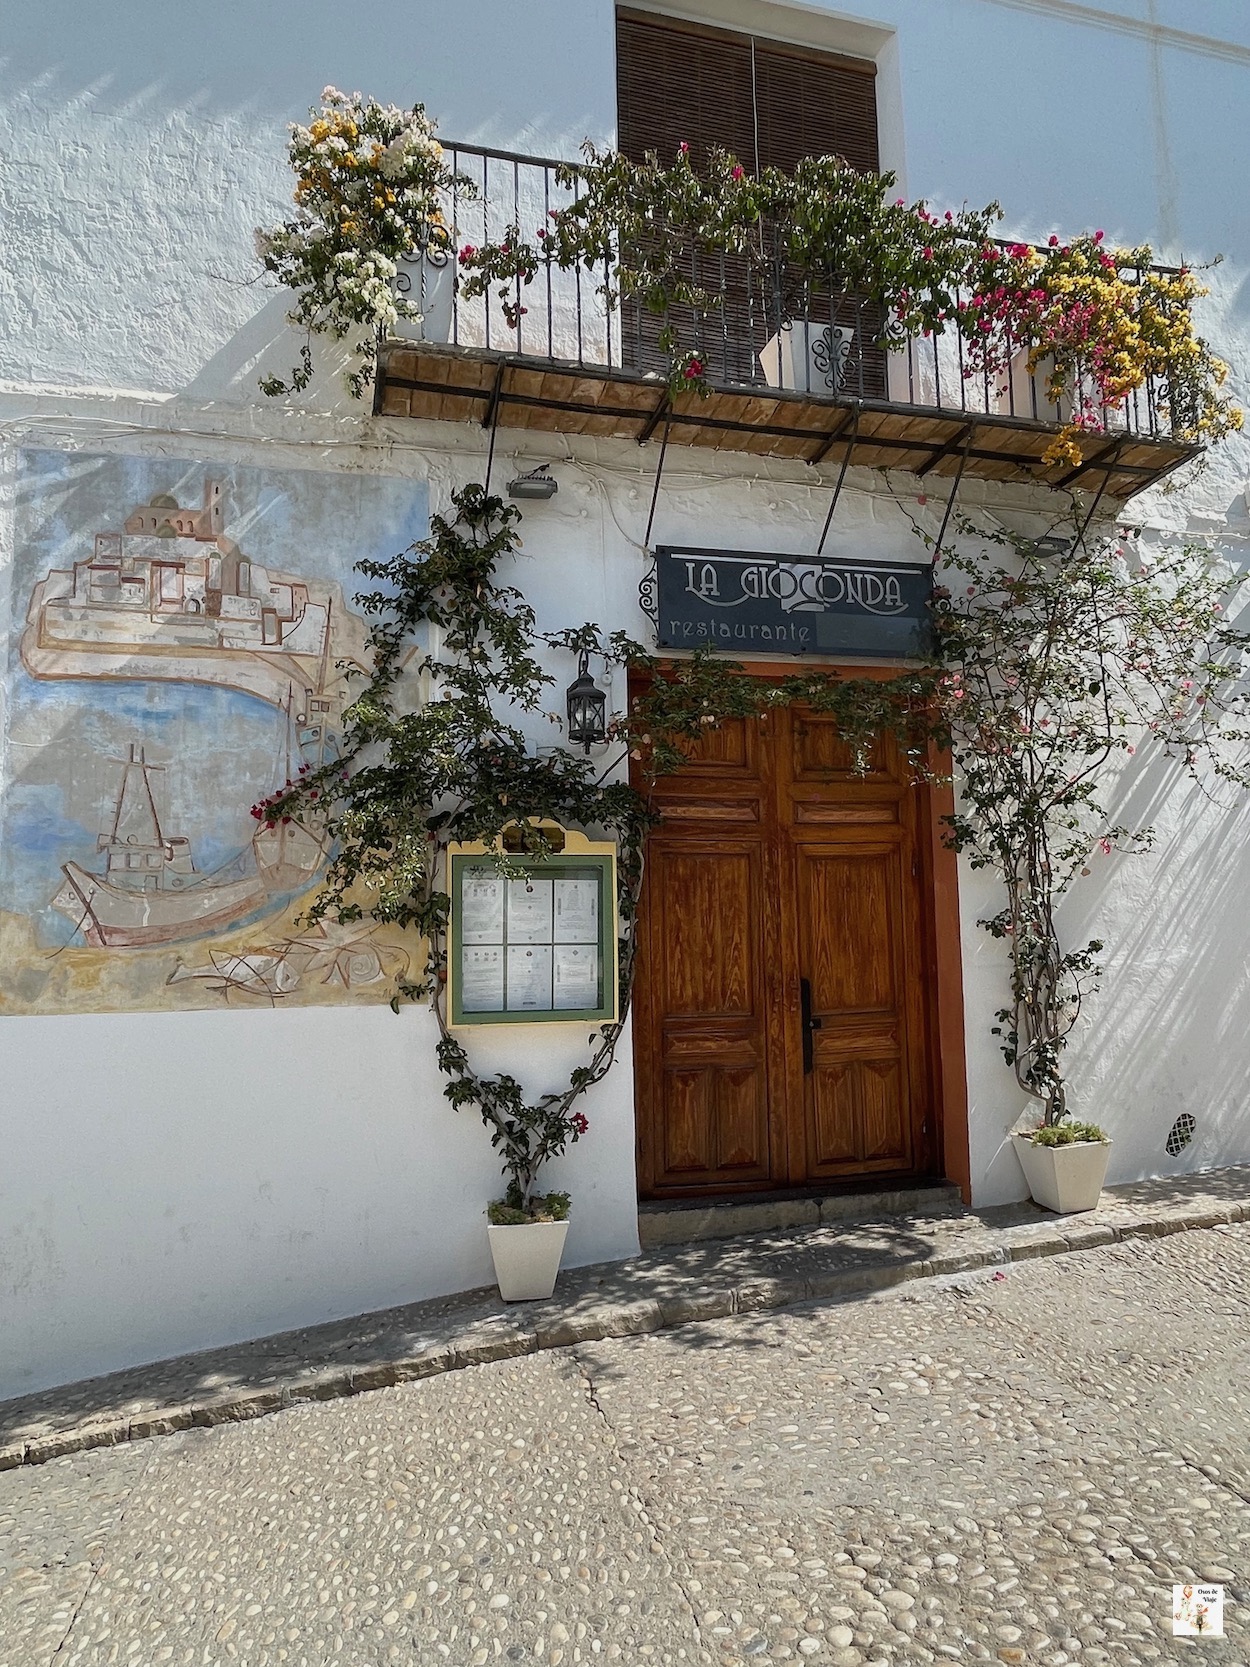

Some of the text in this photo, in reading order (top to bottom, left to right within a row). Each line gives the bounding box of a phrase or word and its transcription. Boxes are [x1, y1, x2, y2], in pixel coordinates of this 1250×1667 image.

[685, 562, 909, 615] LA GIOCONDA
[669, 618, 810, 642] restaurante
